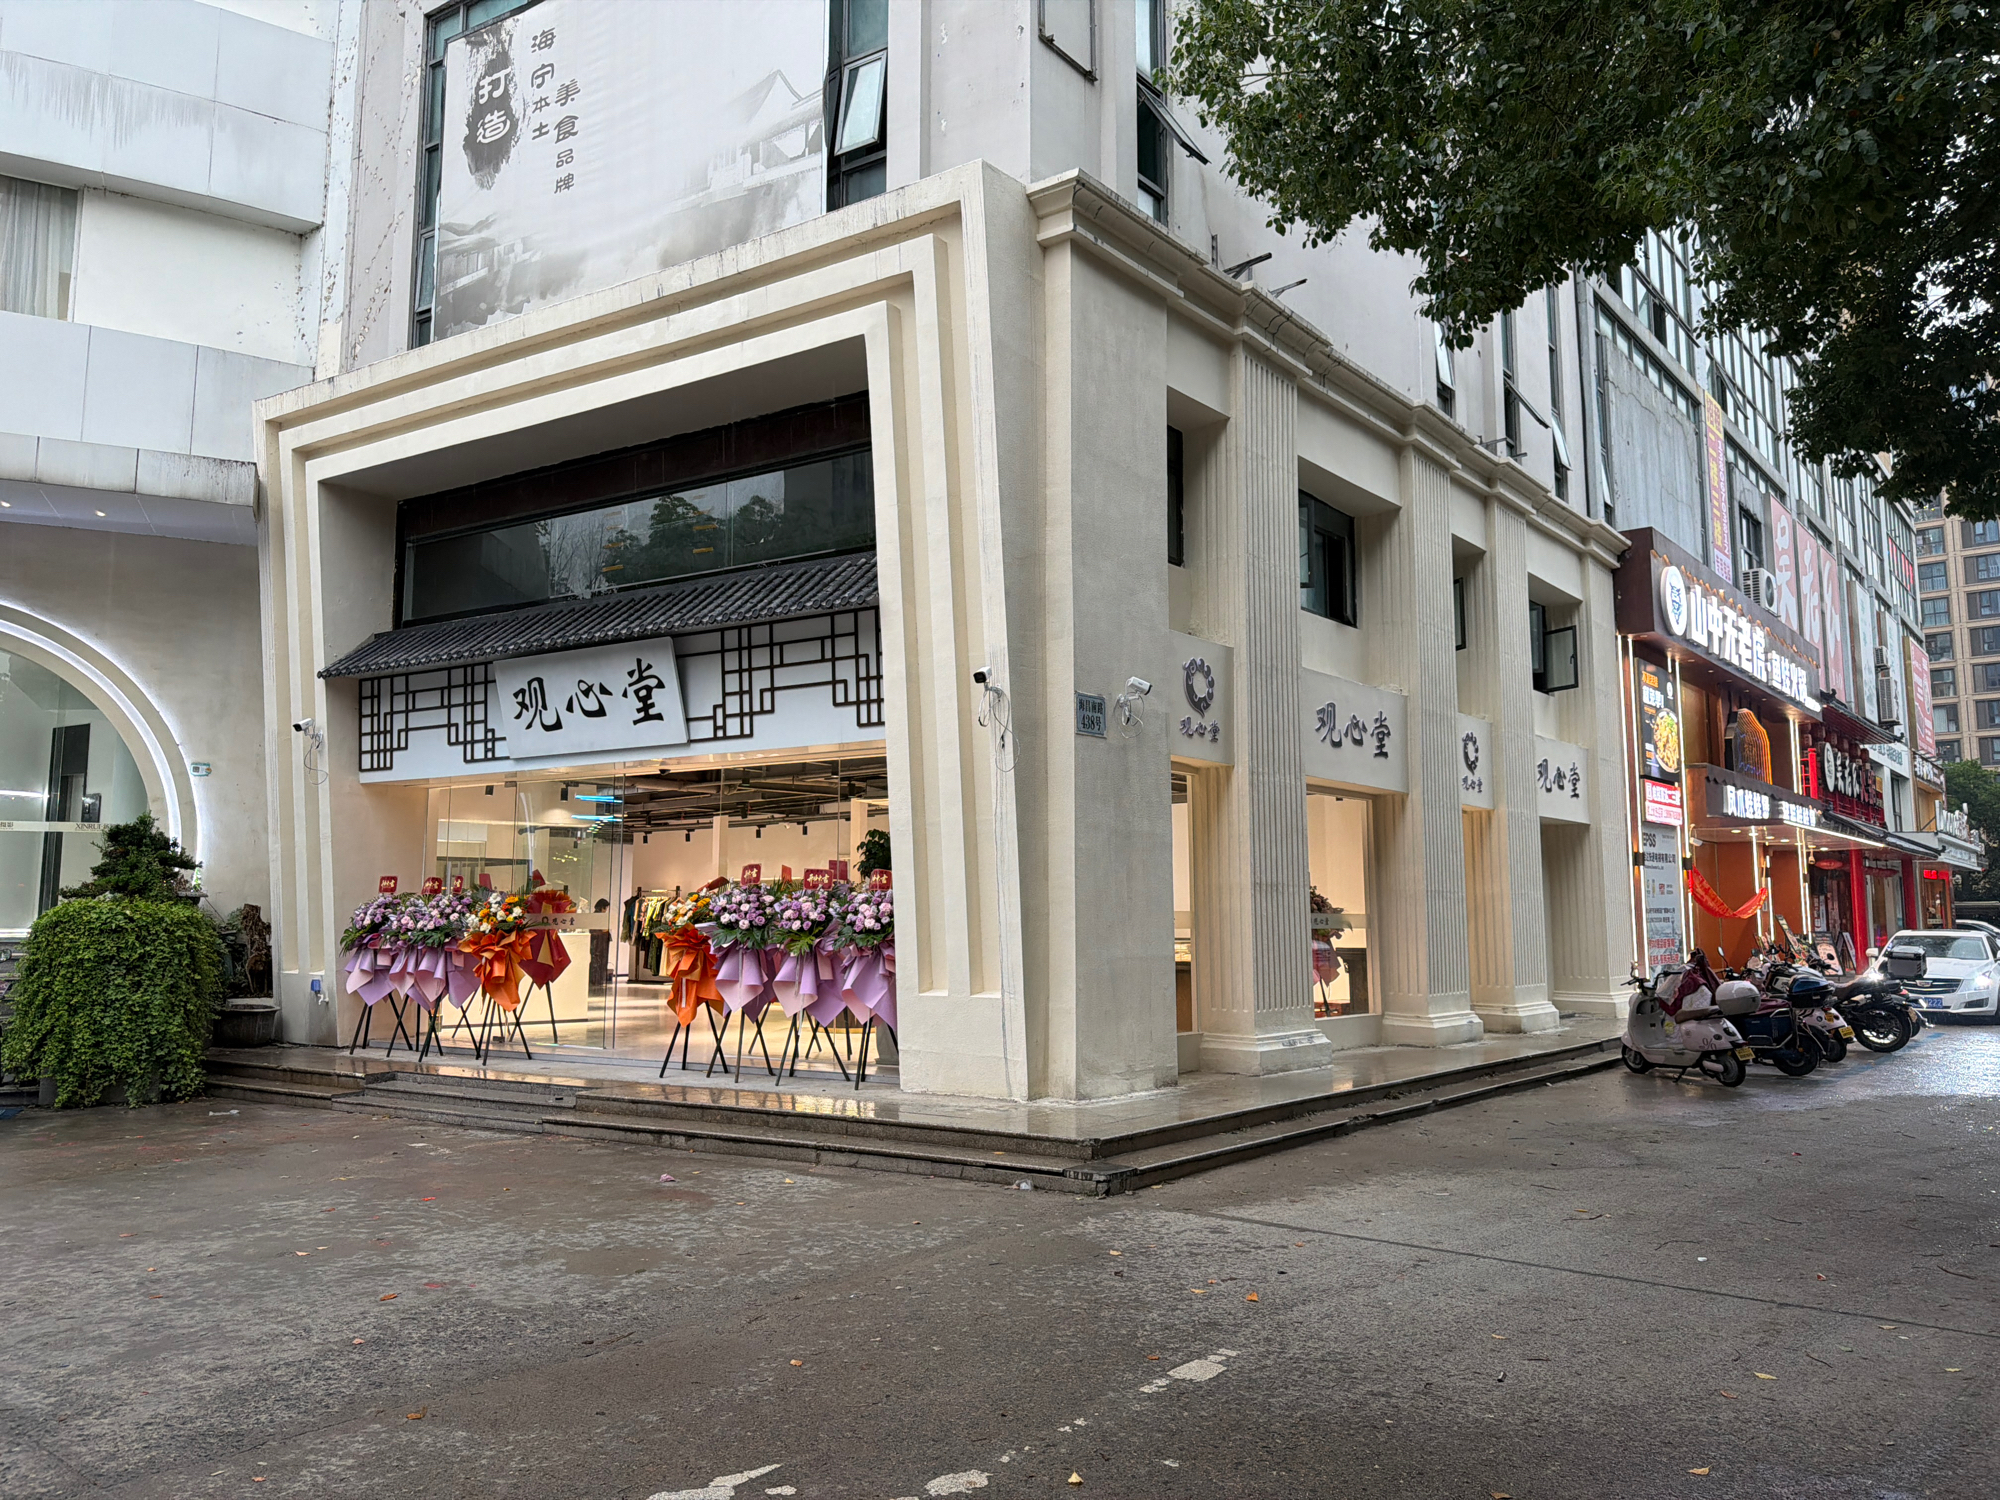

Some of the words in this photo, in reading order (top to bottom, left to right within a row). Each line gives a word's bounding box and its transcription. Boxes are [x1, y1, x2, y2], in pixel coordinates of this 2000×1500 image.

[529, 27, 557, 141] 海宁本土
[475, 66, 512, 146] 打造
[553, 77, 582, 195] 美食品牌
[513, 657, 666, 733] 观心堂
[1078, 698, 1103, 715] 海昌南路
[1080, 713, 1102, 731] 438号
[1179, 715, 1220, 744] 观心堂
[1315, 701, 1392, 760] 观心堂
[1461, 774, 1483, 794] 观心堂
[1536, 757, 1581, 800] 观心堂
[552, 916, 576, 926] 观心堂
